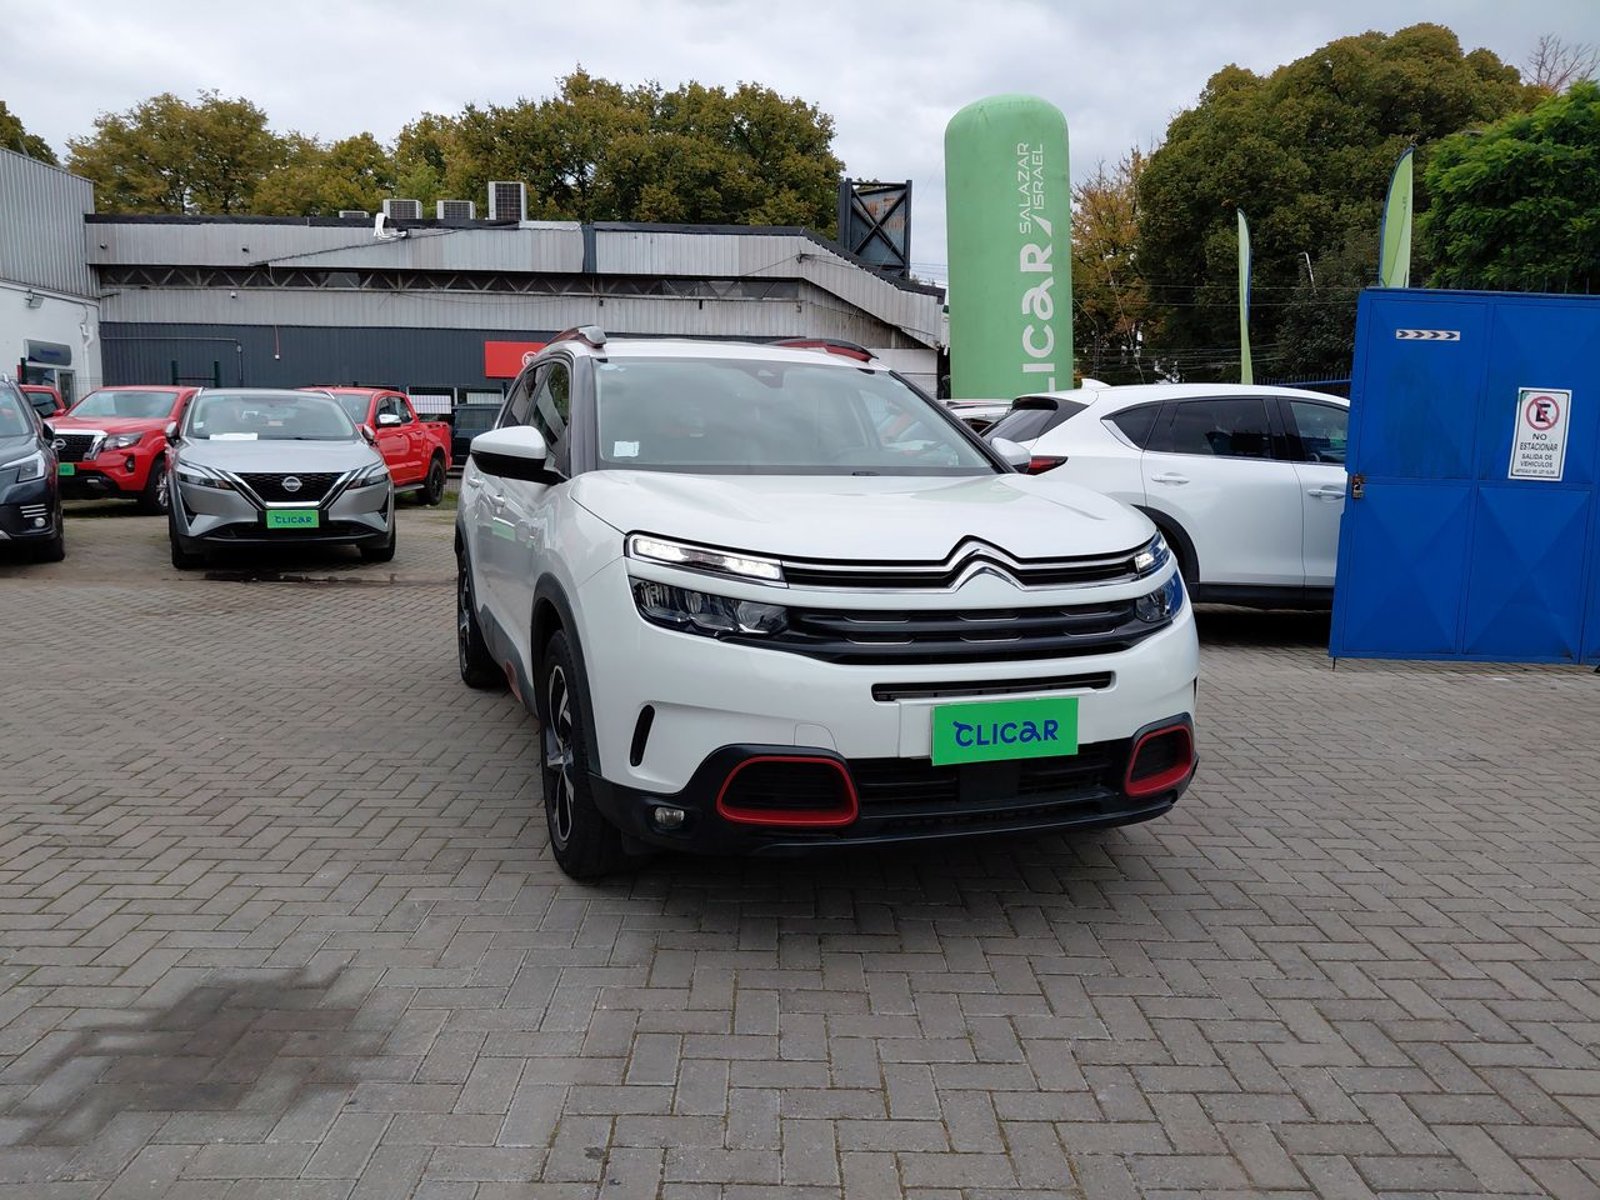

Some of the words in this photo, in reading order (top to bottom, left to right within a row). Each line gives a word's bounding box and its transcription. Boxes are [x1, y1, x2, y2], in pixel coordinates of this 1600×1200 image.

[1017, 142, 1031, 235] SALAZAR
[1032, 143, 1044, 210] ISRAEL
[1520, 442, 1558, 451] ESTACIONAR
